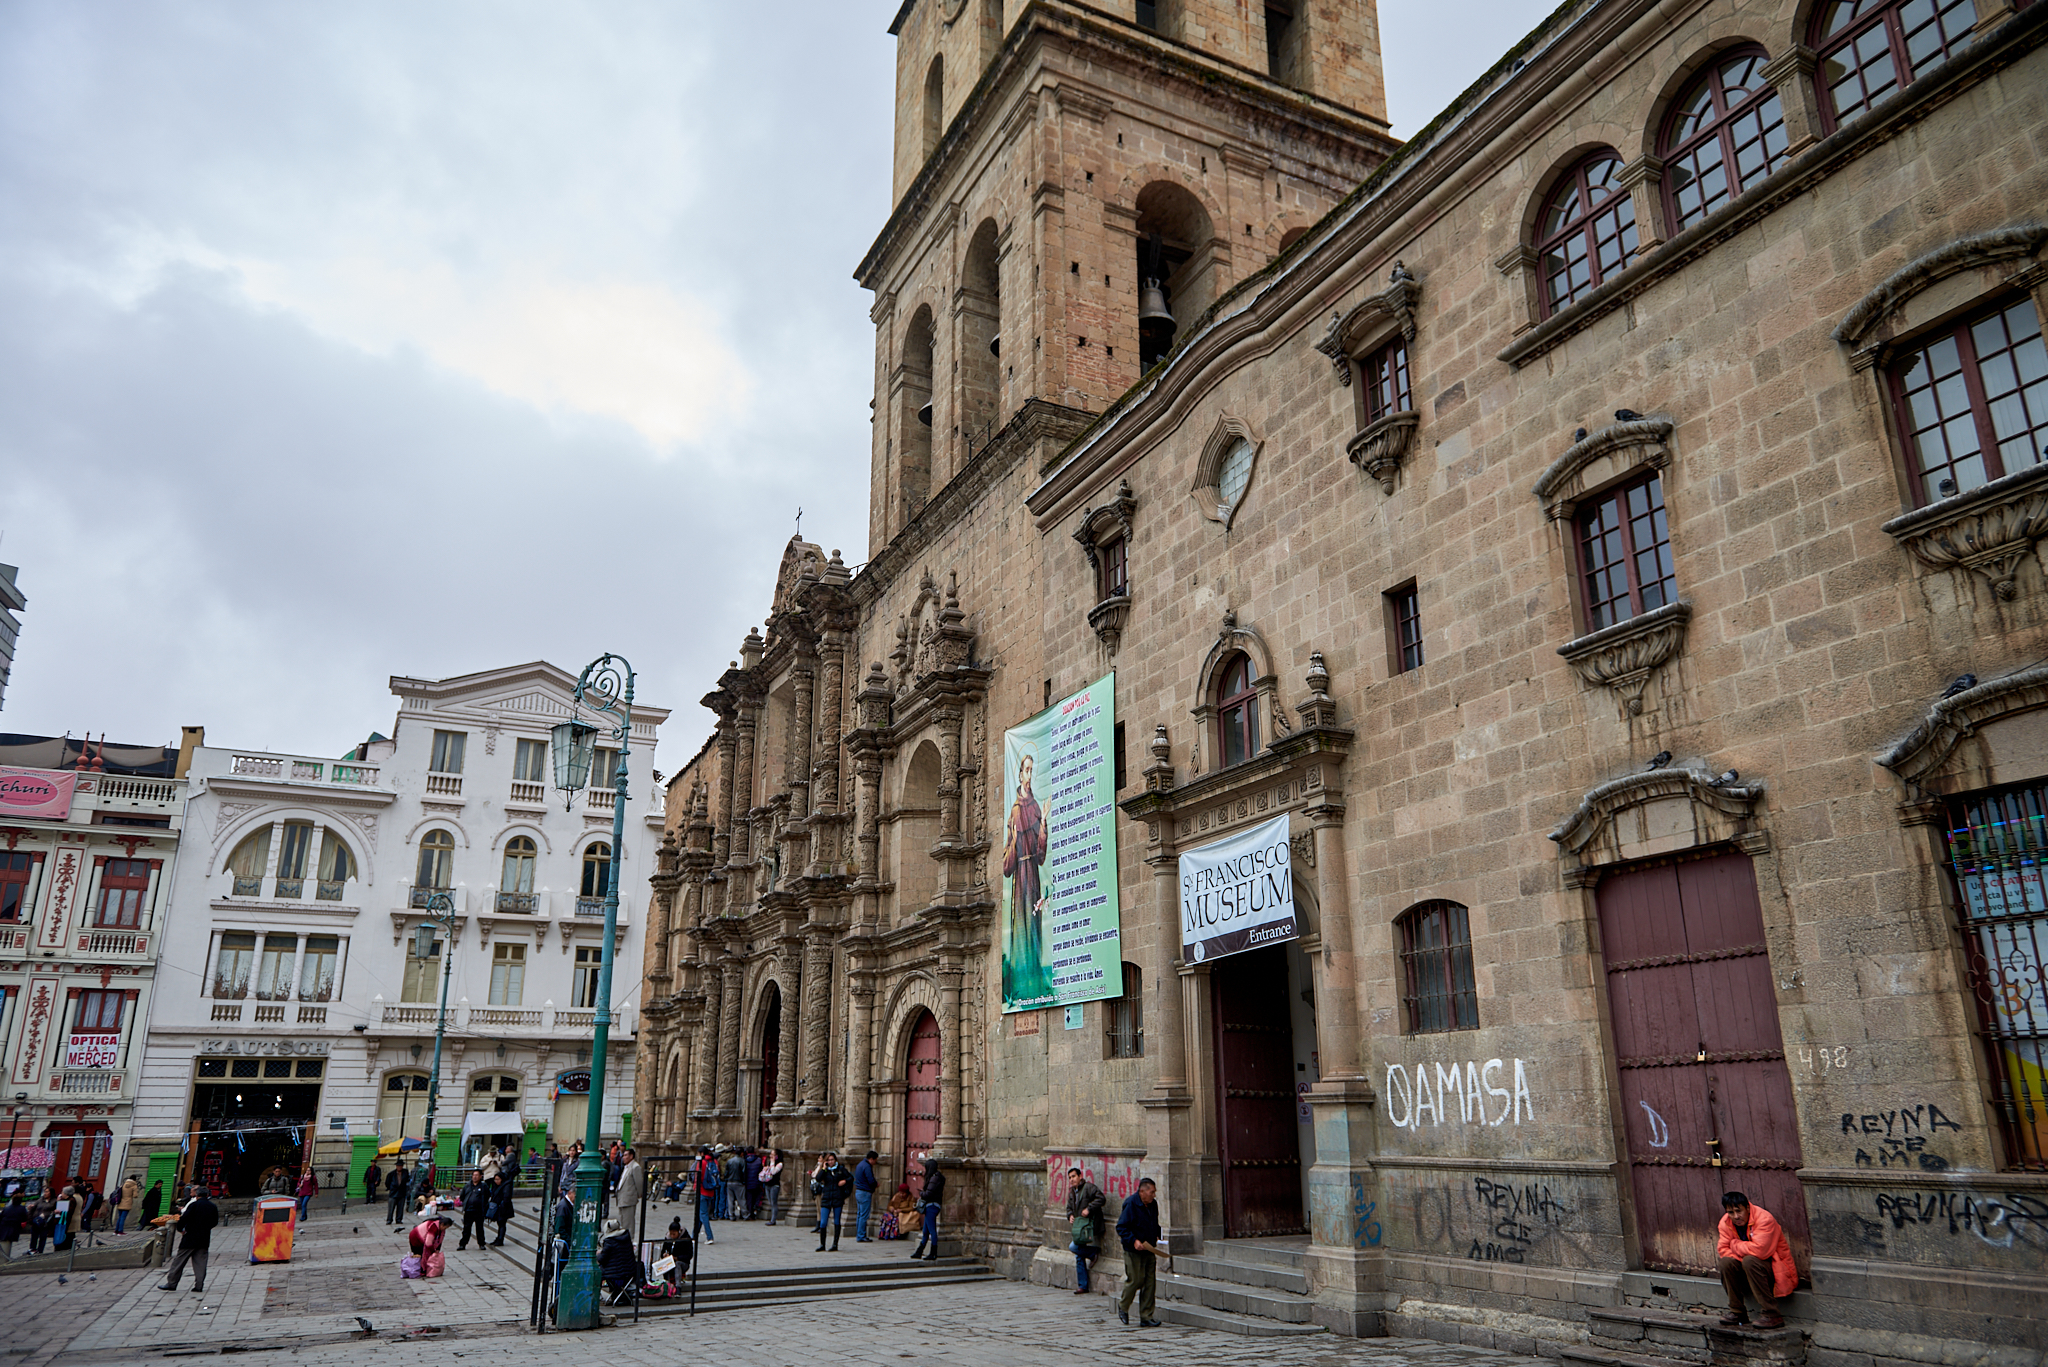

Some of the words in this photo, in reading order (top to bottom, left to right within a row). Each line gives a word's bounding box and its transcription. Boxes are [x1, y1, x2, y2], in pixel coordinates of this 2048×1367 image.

[1195, 842, 1289, 893] FRANCISCO
[1184, 868, 1292, 933] MUSEUM
[1974, 891, 2001, 901] afcta
[2014, 886, 2035, 897] vda
[1249, 924, 1292, 944] Entrance
[70, 1036, 117, 1046] OPTICA
[201, 1040, 329, 1055] KAUTSCH
[67, 1052, 116, 1066] MERCED
[565, 1073, 591, 1083] Clasic
[1385, 1058, 1535, 1132] QAMASA
[1842, 1104, 1961, 1136] REYNA
